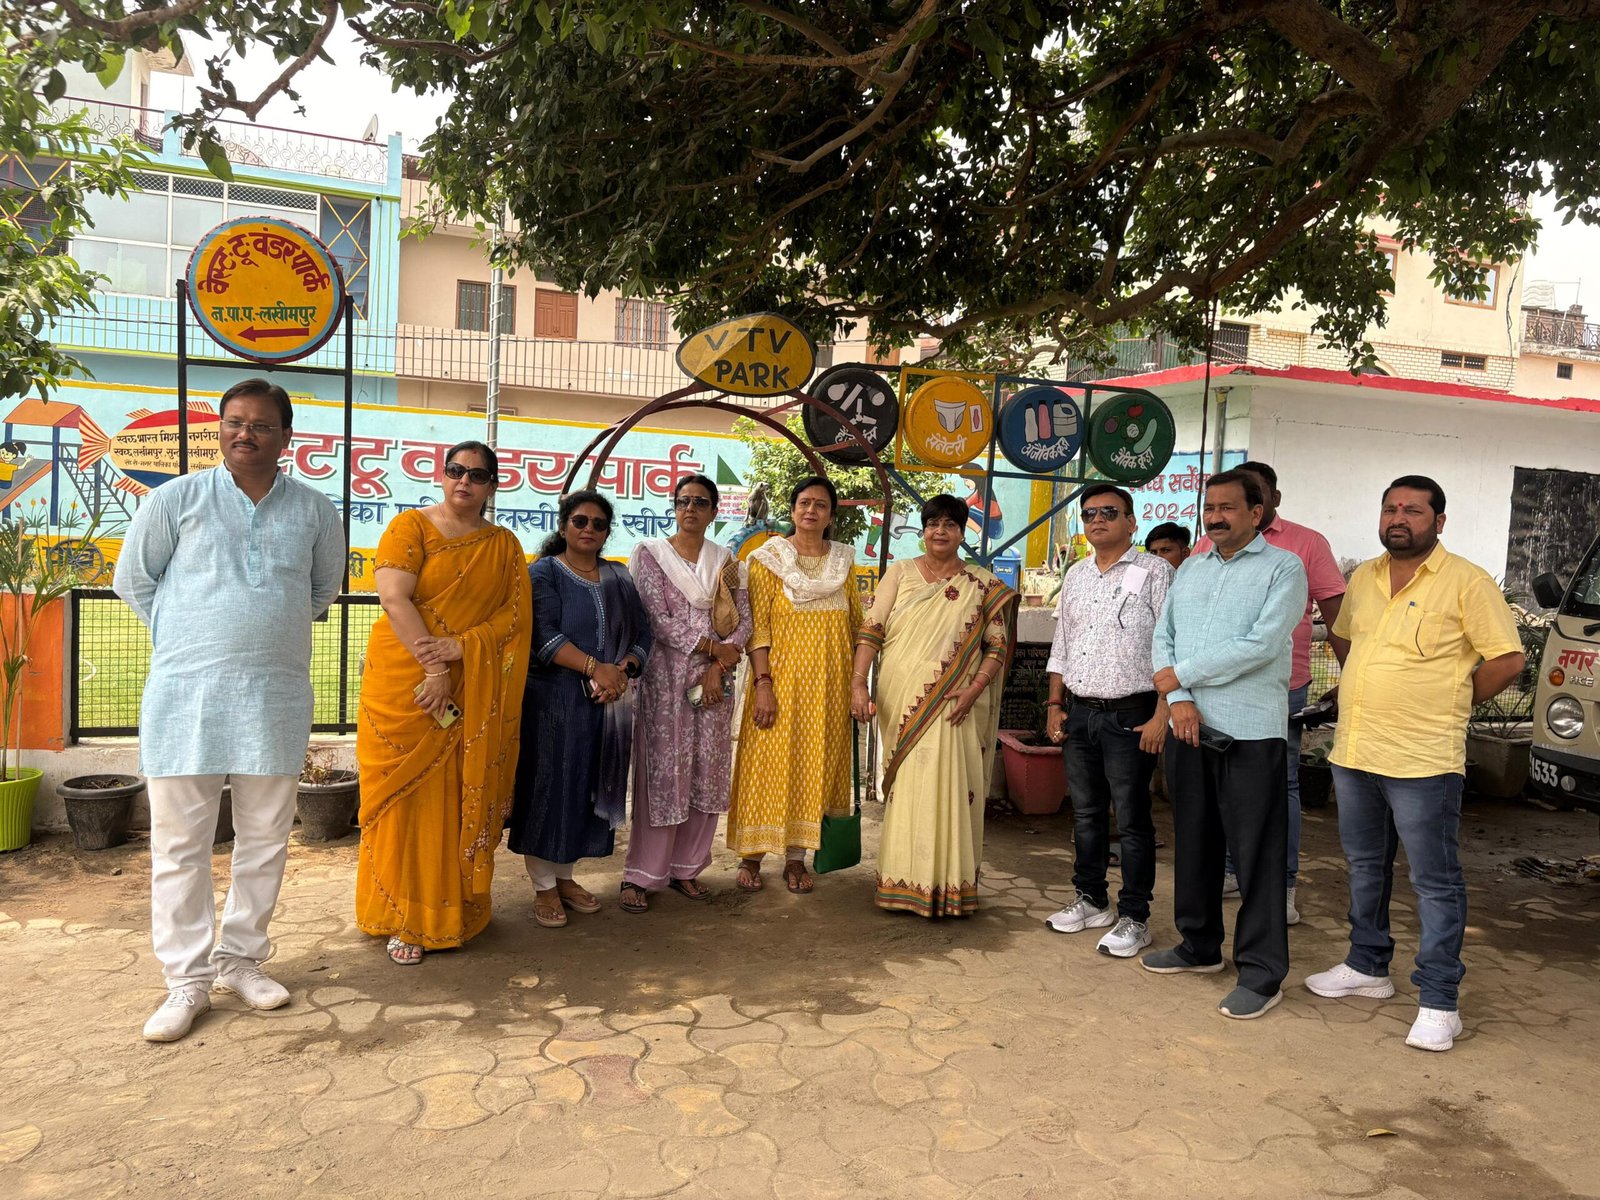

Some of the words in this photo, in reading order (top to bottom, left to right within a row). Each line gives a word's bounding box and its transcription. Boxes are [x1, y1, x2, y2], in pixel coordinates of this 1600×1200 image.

[248, 227, 300, 264] वंडर
[291, 250, 331, 292] पार्क
[704, 327, 792, 354] VTV
[714, 359, 790, 389] PARK
[188, 428, 220, 442] नगरीय
[1142, 502, 1197, 522] 2024
[1558, 649, 1600, 675] नगर
